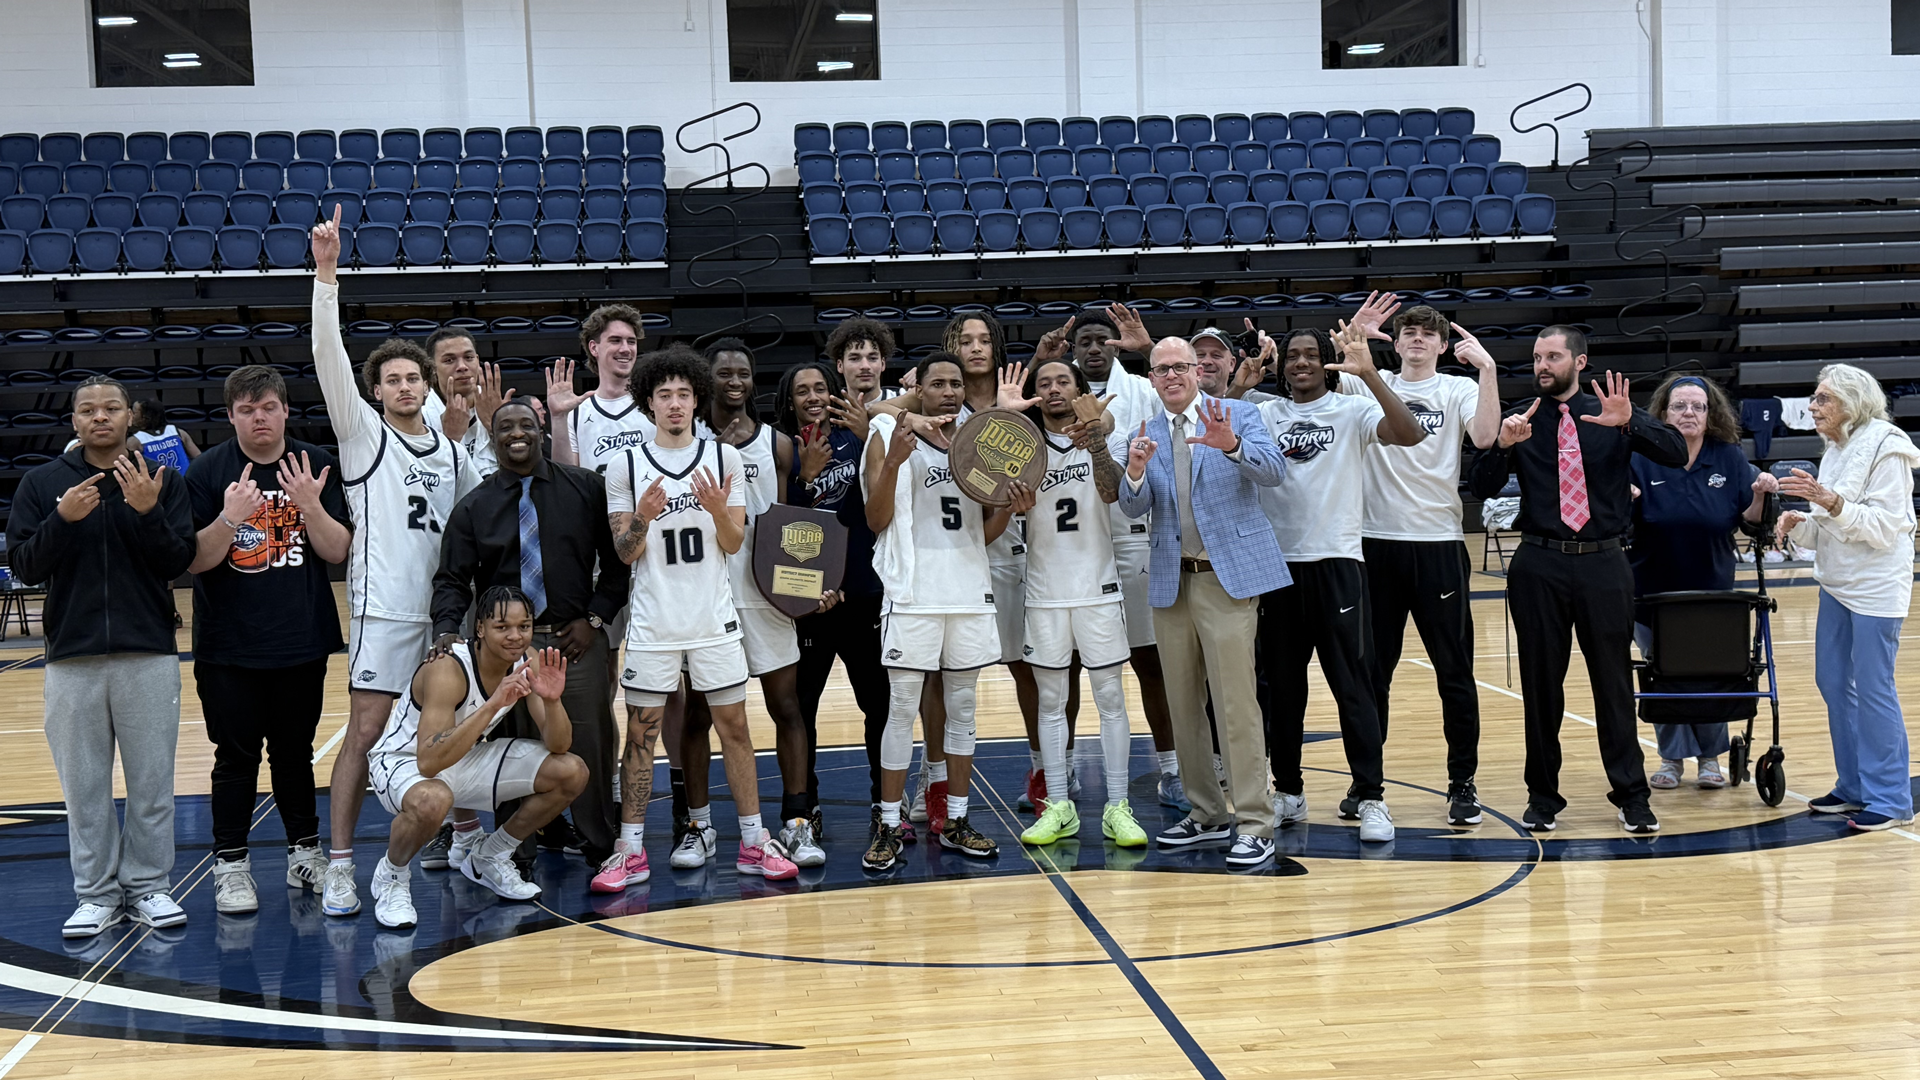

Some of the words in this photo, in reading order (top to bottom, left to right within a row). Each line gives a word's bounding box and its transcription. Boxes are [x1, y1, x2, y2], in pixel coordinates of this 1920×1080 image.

[147, 438, 179, 453] BULLDOGS
[594, 430, 643, 457] STORM
[979, 421, 1034, 461] NJCAA
[1278, 426, 1335, 453] STORM
[813, 461, 856, 500] STORM
[1007, 462, 1019, 474] 10
[1040, 462, 1089, 492] STORM
[940, 496, 962, 530] 5
[1055, 497, 1079, 532] 2
[233, 529, 266, 546] TORM
[269, 526, 306, 546] LIK
[661, 527, 704, 566] 10
[782, 528, 822, 546] NJCAA
[270, 546, 303, 567] US
[804, 638, 812, 646] 11
